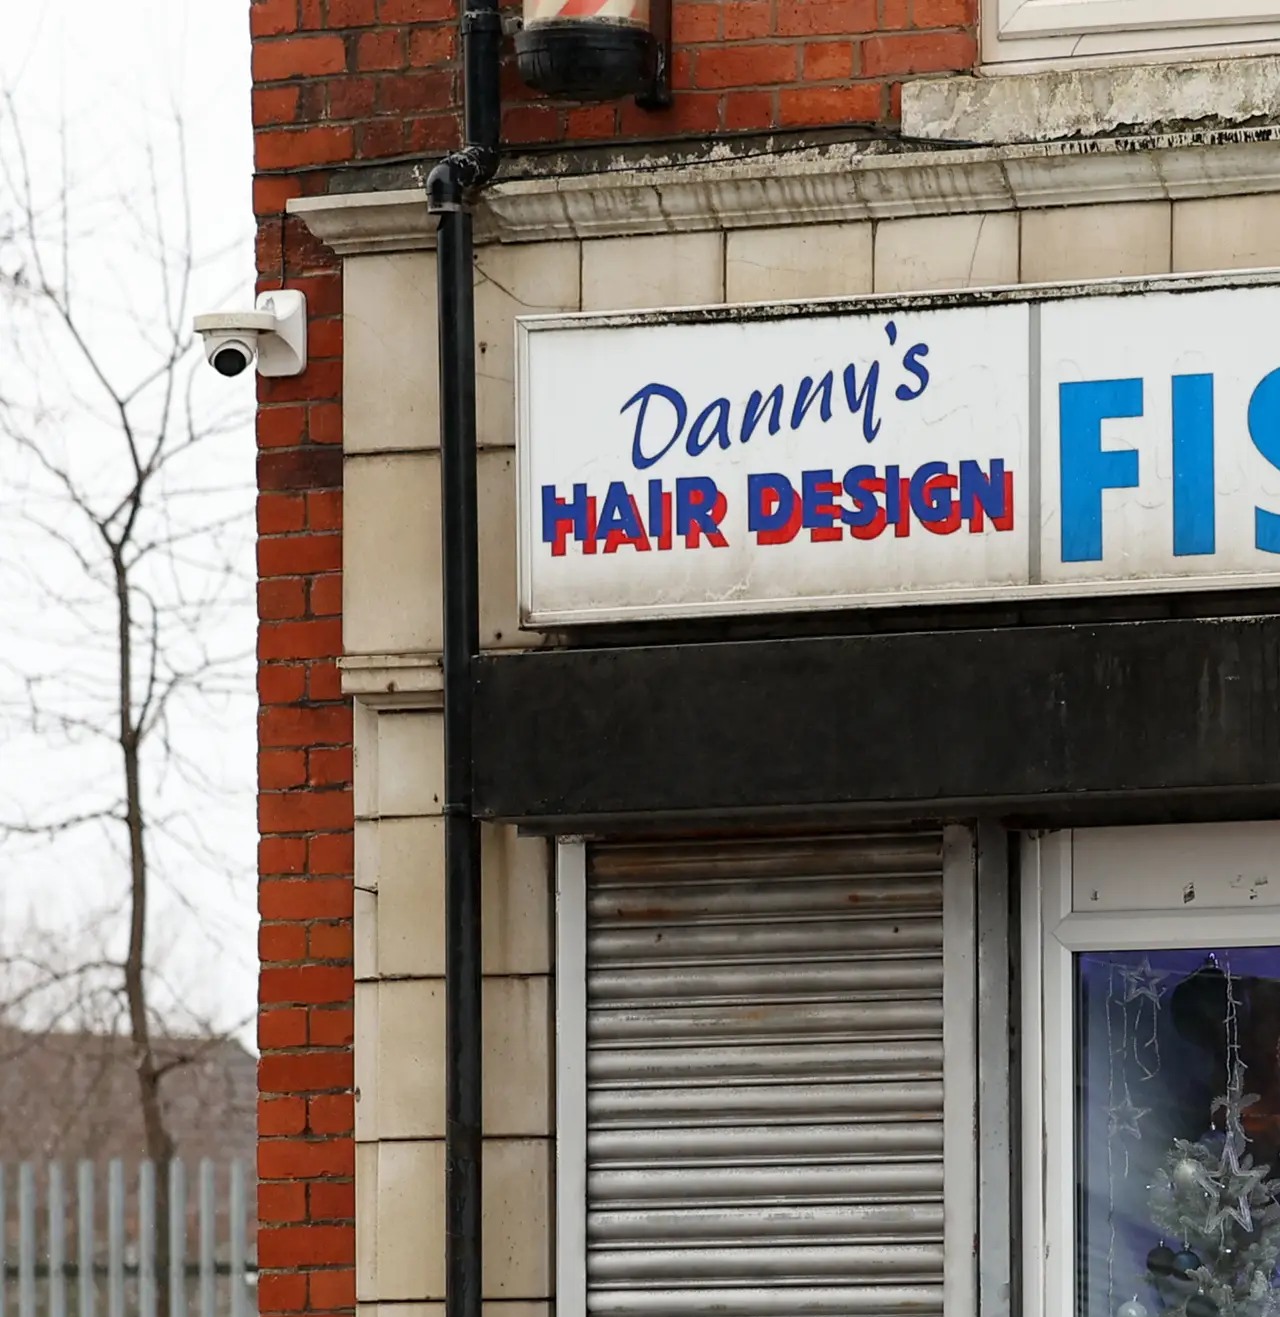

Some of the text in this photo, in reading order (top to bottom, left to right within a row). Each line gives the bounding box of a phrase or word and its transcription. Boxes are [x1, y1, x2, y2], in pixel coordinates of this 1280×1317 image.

[620, 319, 930, 470] Danny's
[541, 457, 1014, 557] HAIR DESIGN
